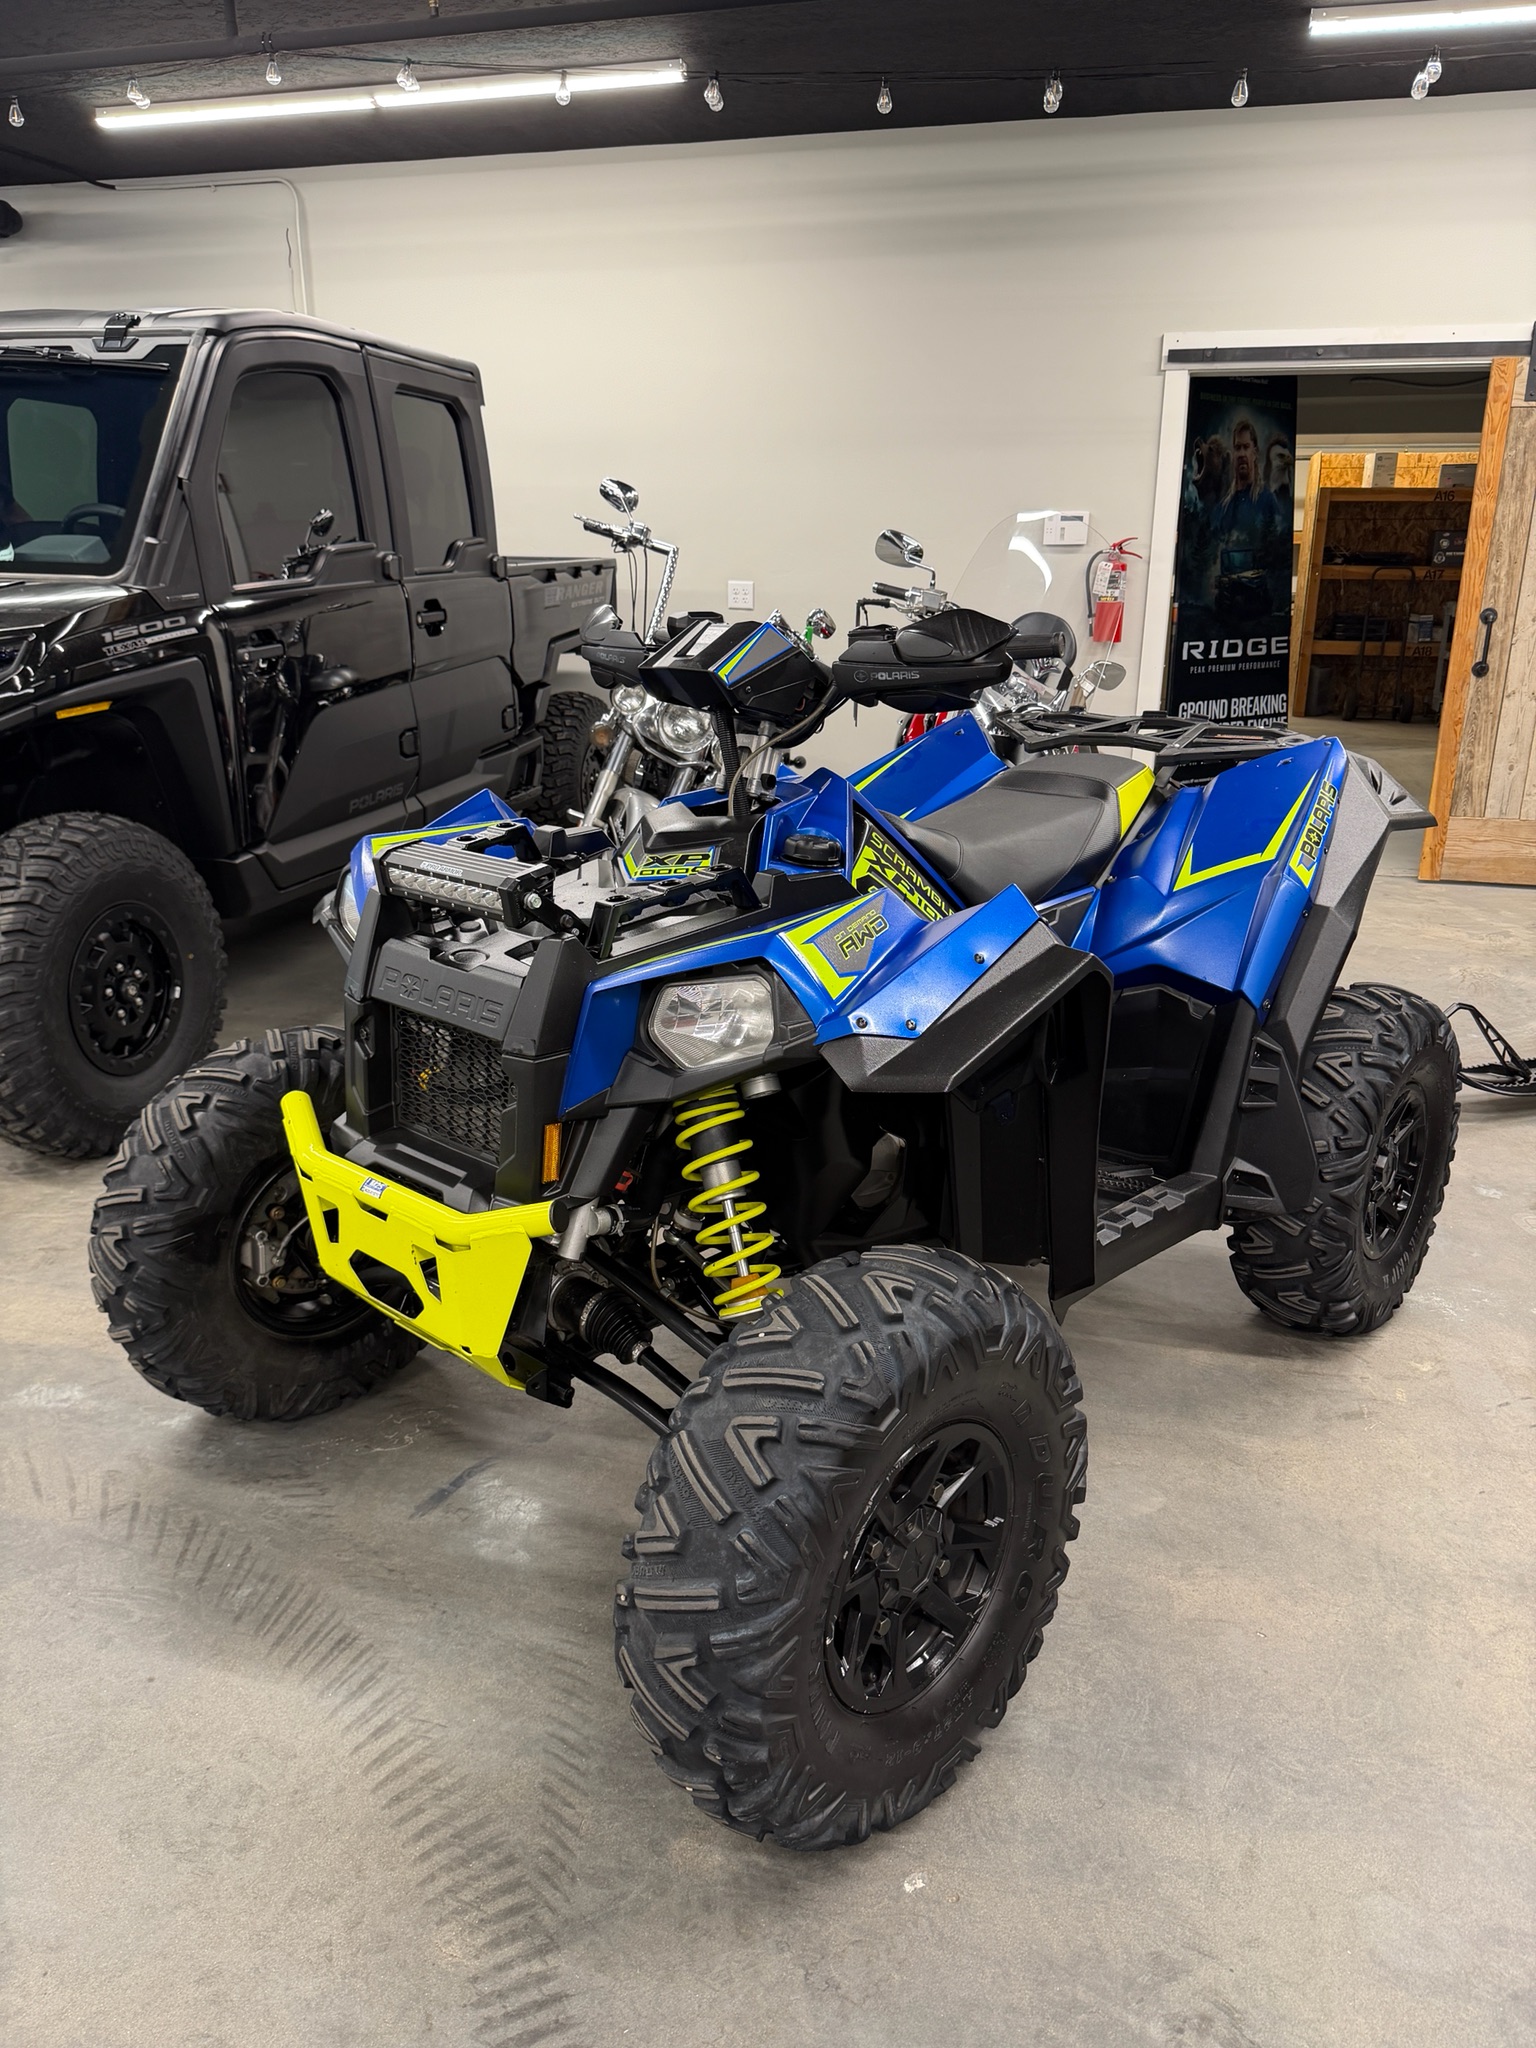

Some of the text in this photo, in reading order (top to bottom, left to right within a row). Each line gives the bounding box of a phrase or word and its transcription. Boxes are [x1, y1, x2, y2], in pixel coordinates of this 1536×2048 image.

[1434, 490, 1456, 501] A16
[1423, 569, 1445, 580] A17
[557, 581, 604, 600] RANGER
[101, 616, 187, 643] 1500
[102, 638, 149, 656] TEXAS
[1182, 636, 1289, 661] RIDGE
[1412, 646, 1433, 656] A18
[870, 670, 920, 681] POLARIS
[1190, 660, 1281, 674] PEAK PREMIUM PERFORMANCE
[1179, 693, 1287, 720] GROUND BREAKING
[349, 783, 405, 814] POLARIS
[1299, 779, 1338, 862] POLARIS
[643, 853, 711, 867] XP
[837, 914, 890, 960] AWD
[379, 965, 504, 1029] POLARIS
